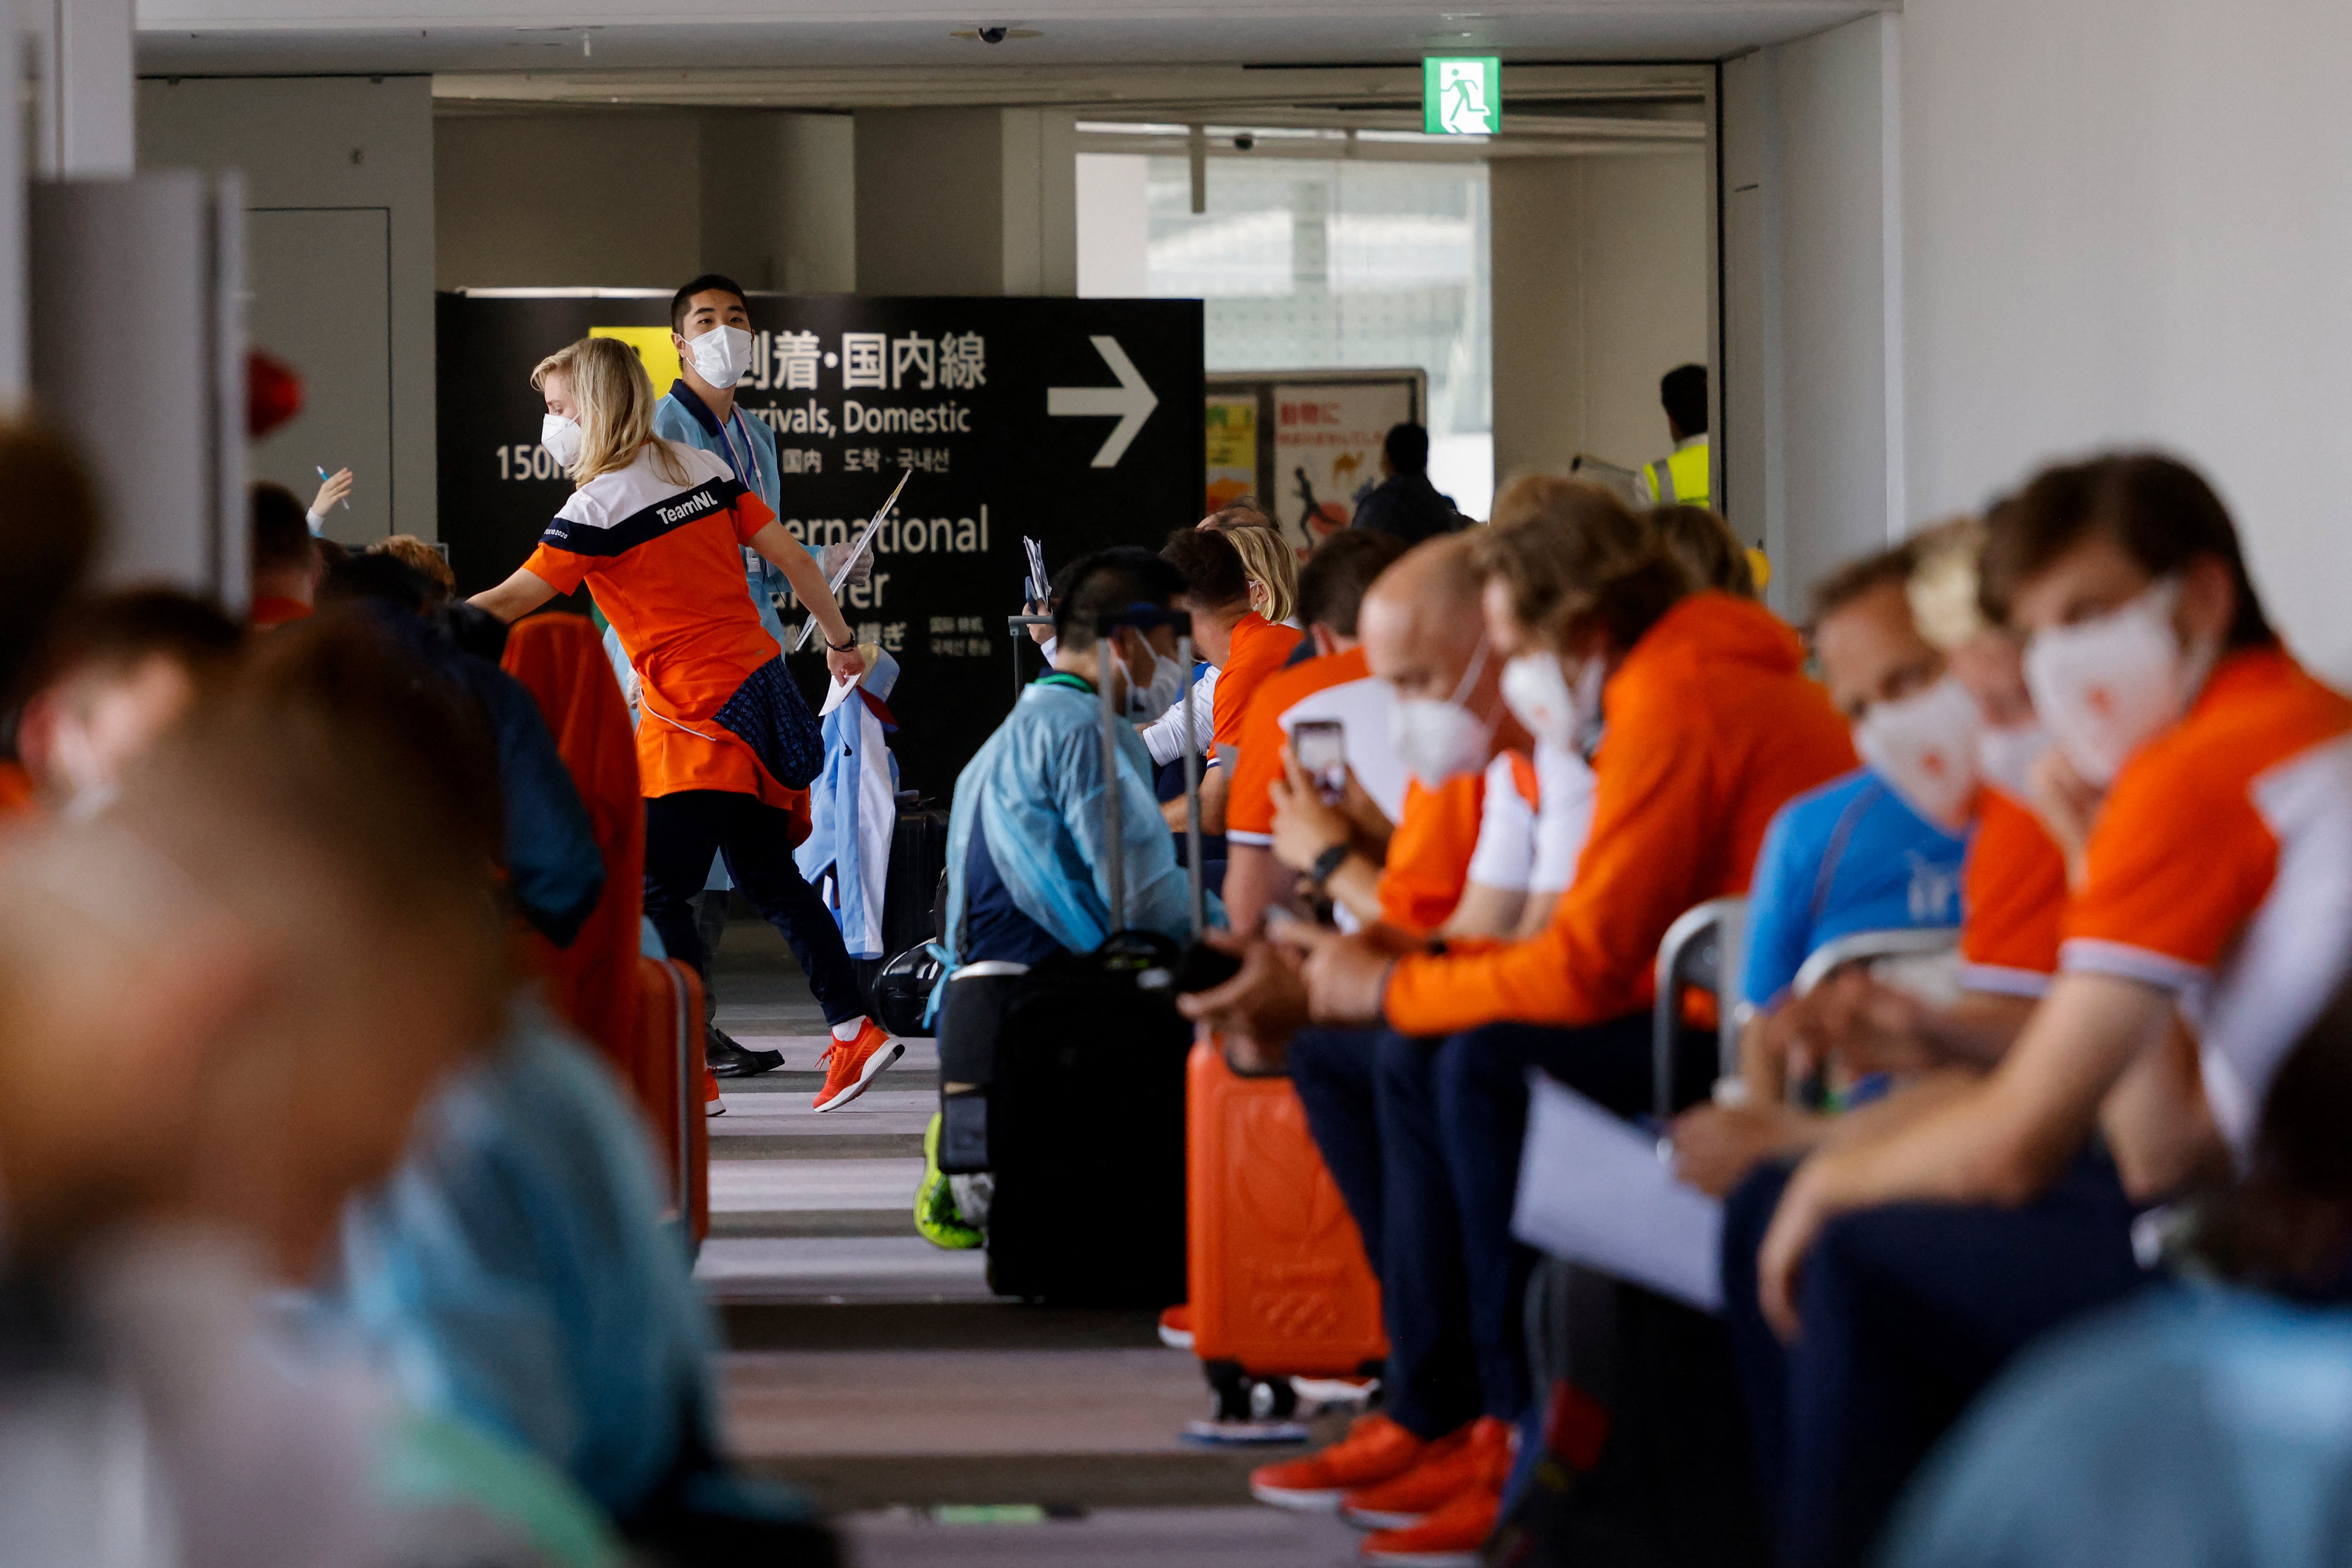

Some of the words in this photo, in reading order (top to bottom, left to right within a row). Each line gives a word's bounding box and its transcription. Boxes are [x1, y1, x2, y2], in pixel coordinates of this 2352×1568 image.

[734, 397, 836, 439] rivals,
[844, 400, 971, 434] Domestic
[656, 490, 718, 525] TeamNL
[555, 529, 568, 539] 2020
[784, 503, 989, 553] ernational
